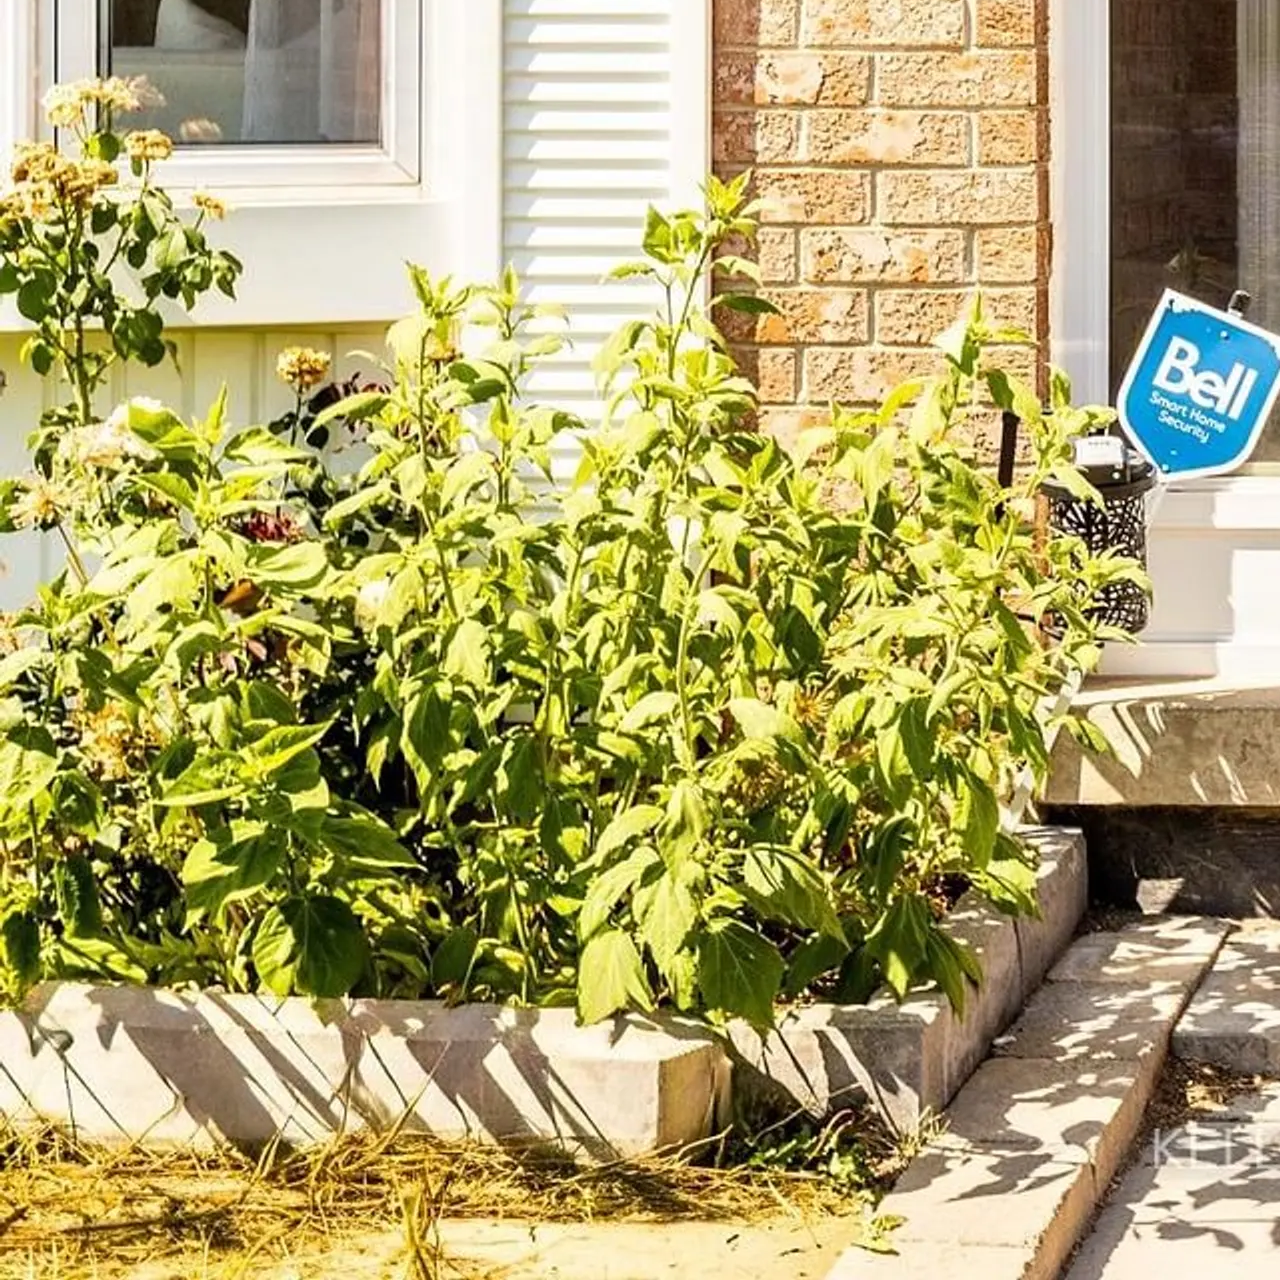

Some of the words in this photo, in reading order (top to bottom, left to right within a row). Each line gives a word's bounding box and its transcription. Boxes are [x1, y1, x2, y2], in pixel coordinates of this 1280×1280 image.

[1151, 335, 1259, 421] Bell
[1149, 390, 1188, 417] Smart
[1189, 408, 1226, 433] Home
[1158, 409, 1210, 443] Security
